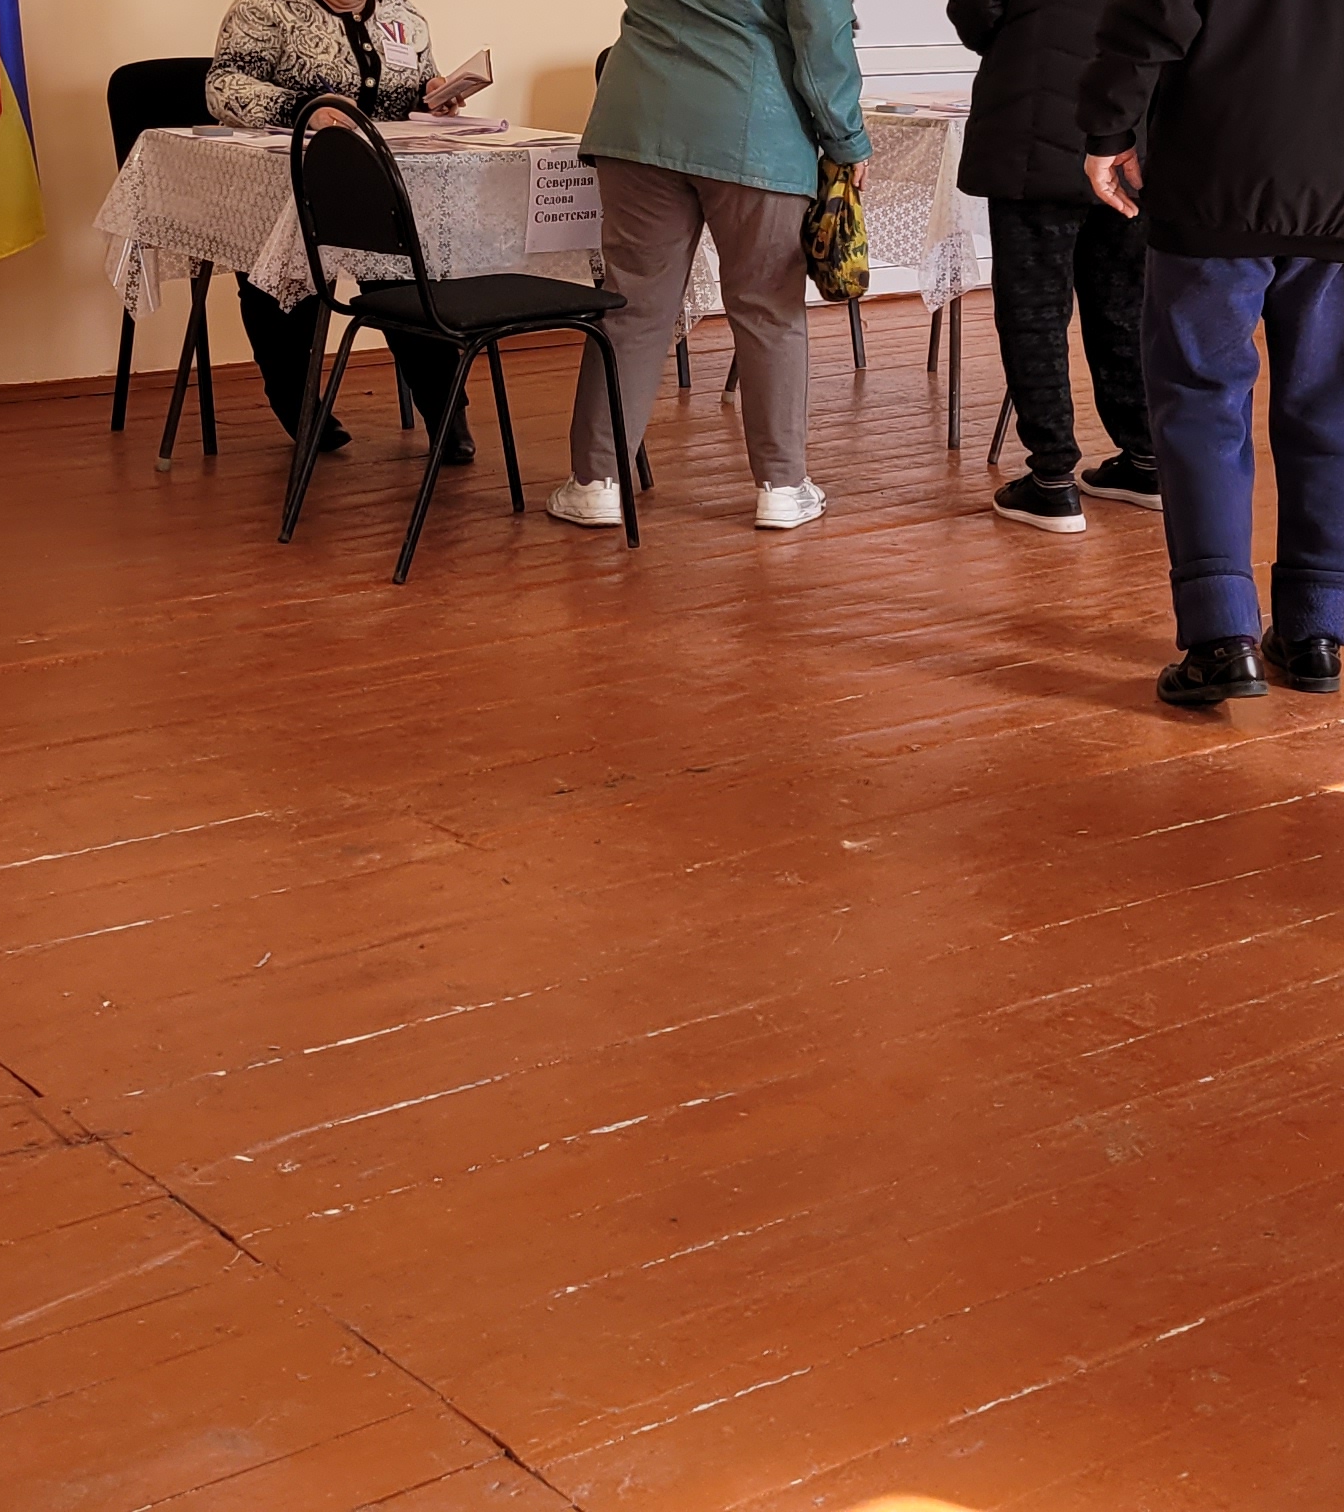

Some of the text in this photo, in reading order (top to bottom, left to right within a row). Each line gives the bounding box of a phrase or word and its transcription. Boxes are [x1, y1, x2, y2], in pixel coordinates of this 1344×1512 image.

[536, 176, 594, 190] Северная
[535, 194, 574, 206] Седова
[534, 210, 597, 223] Советская
